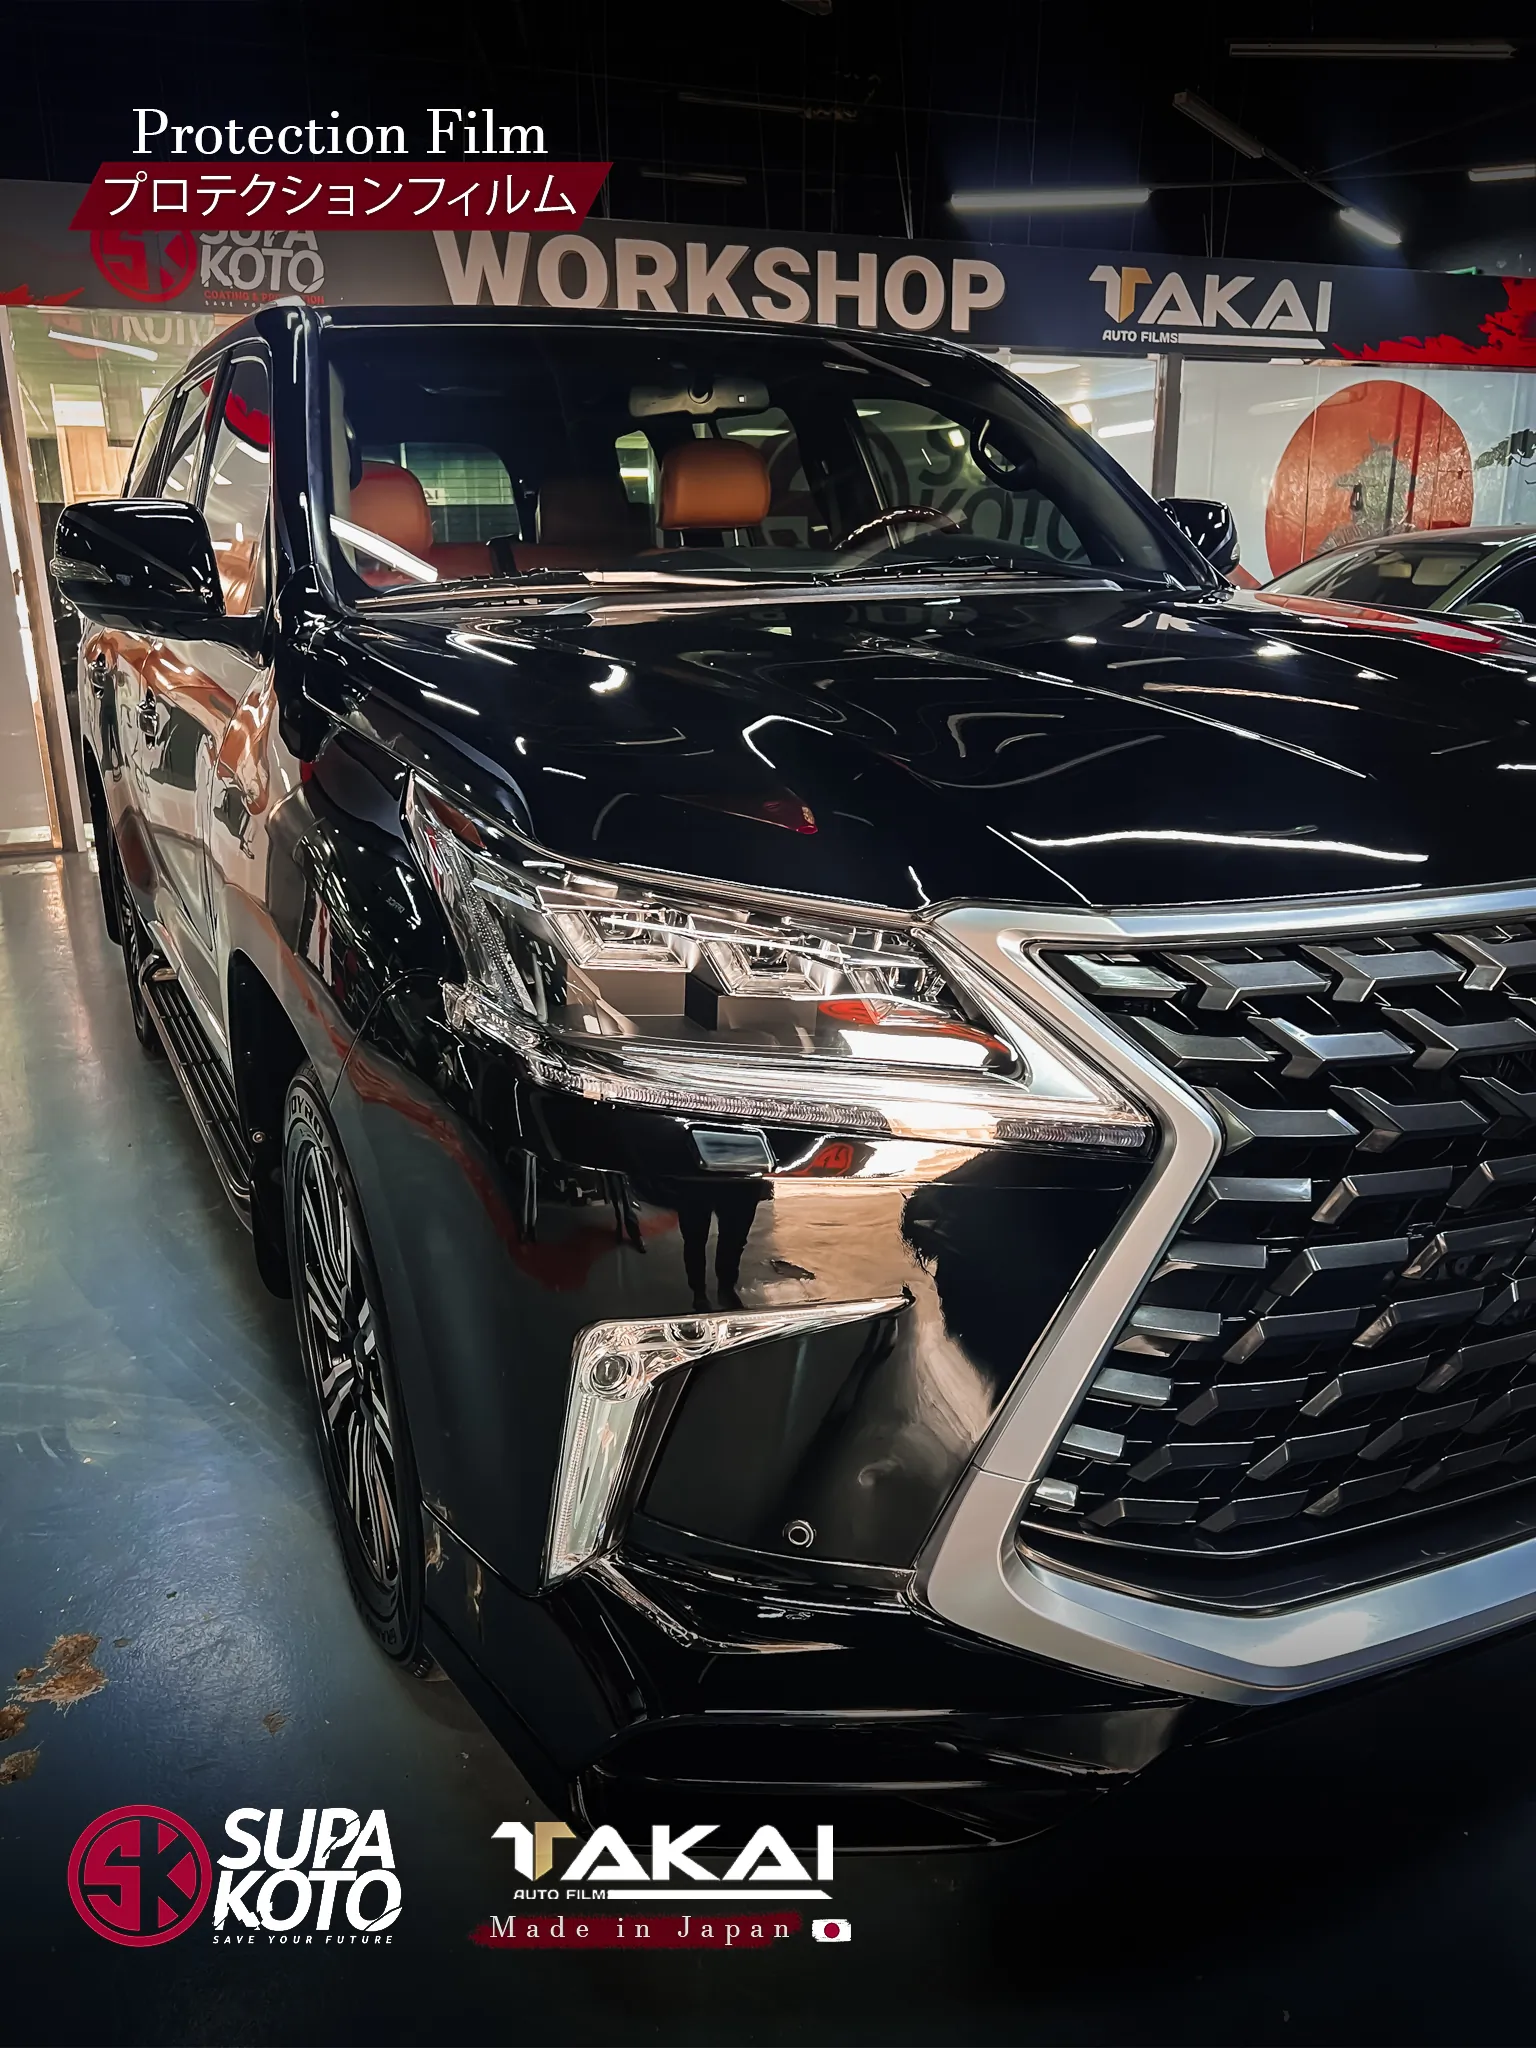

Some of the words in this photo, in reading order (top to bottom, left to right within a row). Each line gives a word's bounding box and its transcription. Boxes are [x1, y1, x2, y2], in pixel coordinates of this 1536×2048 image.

[200, 244, 325, 293] KOTO
[434, 230, 1006, 332] WORKSHOP
[203, 290, 250, 301] COATING
[1089, 264, 1333, 333] TAKAI
[1102, 329, 1138, 342] AUTO
